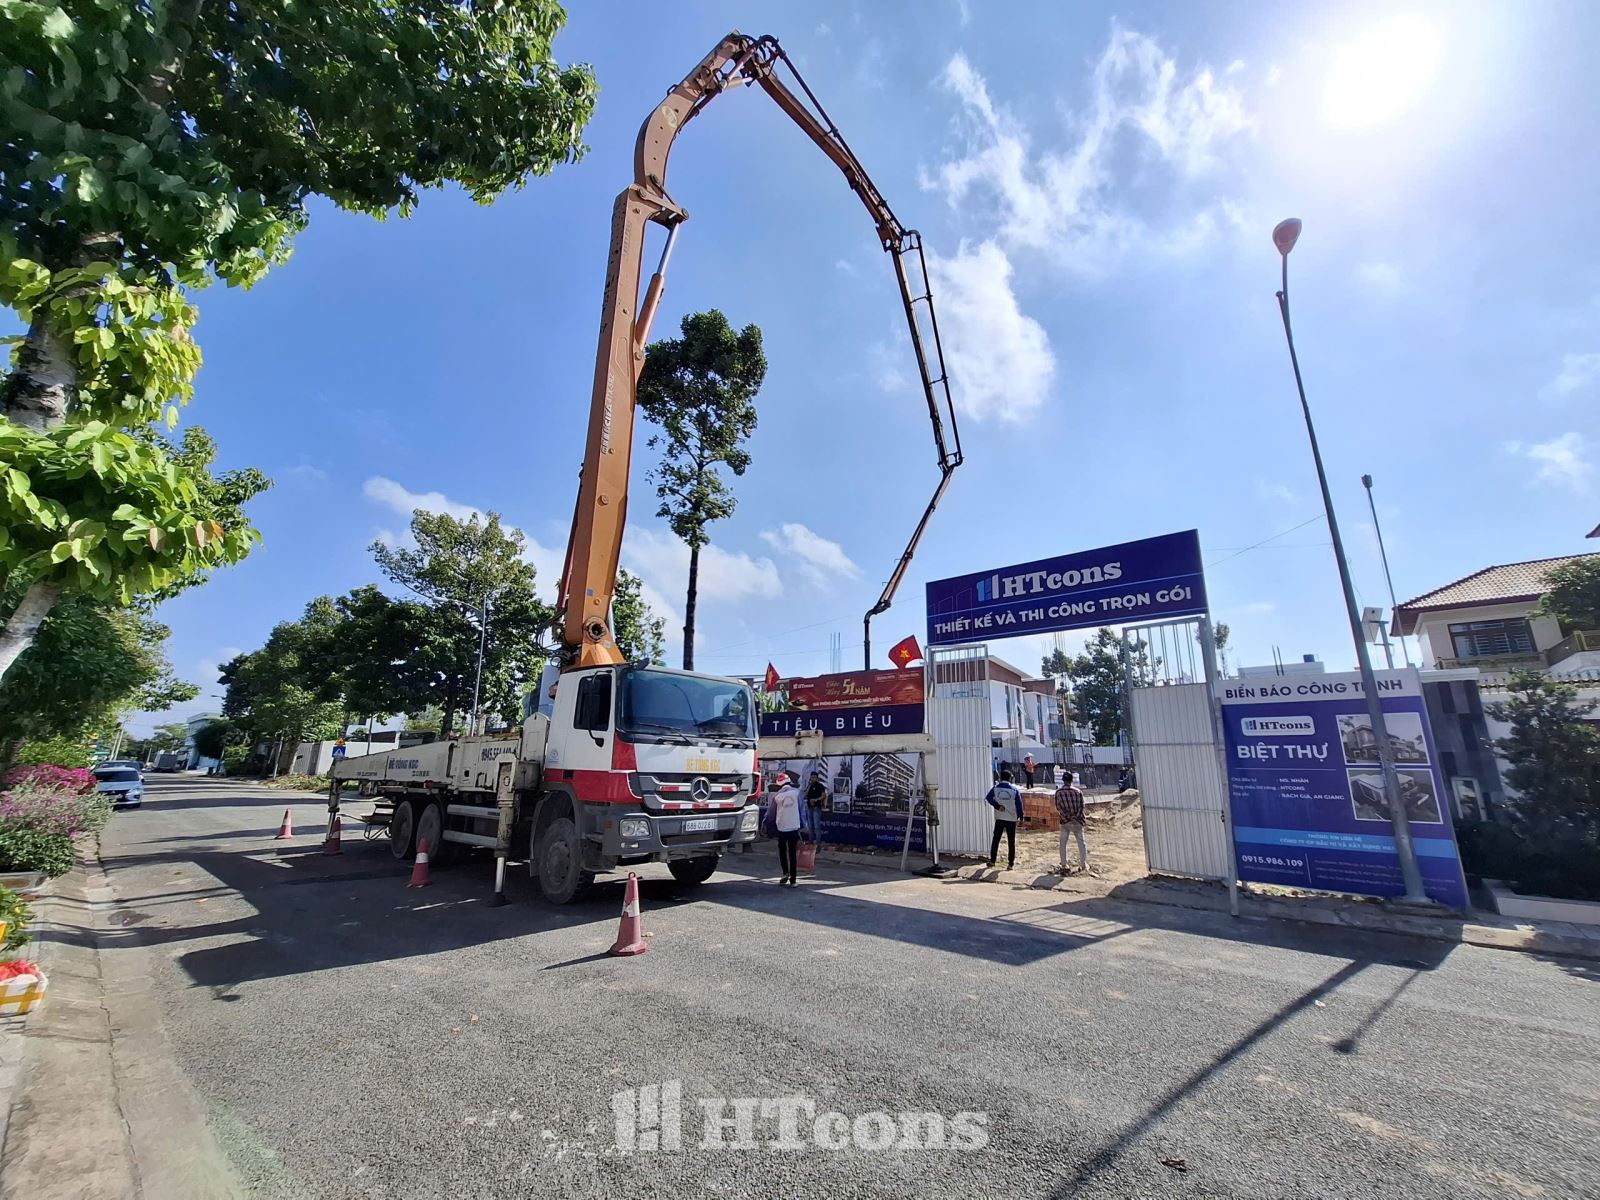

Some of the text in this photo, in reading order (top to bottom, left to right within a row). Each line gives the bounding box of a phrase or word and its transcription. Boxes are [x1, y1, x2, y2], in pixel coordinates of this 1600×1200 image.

[1002, 562, 1122, 598] HTcons
[935, 584, 1191, 634] THIẾT KẾ VÀ THI CÔNG TRỌN GÓI
[1225, 679, 1403, 699] BIỂN BÁO CÔNG TNH
[773, 711, 891, 732] TIÊU BIỂU
[1259, 720, 1311, 731] HTcons
[1237, 742, 1328, 762] BIỆT THỰ
[1241, 854, 1304, 868] 0915.986.109
